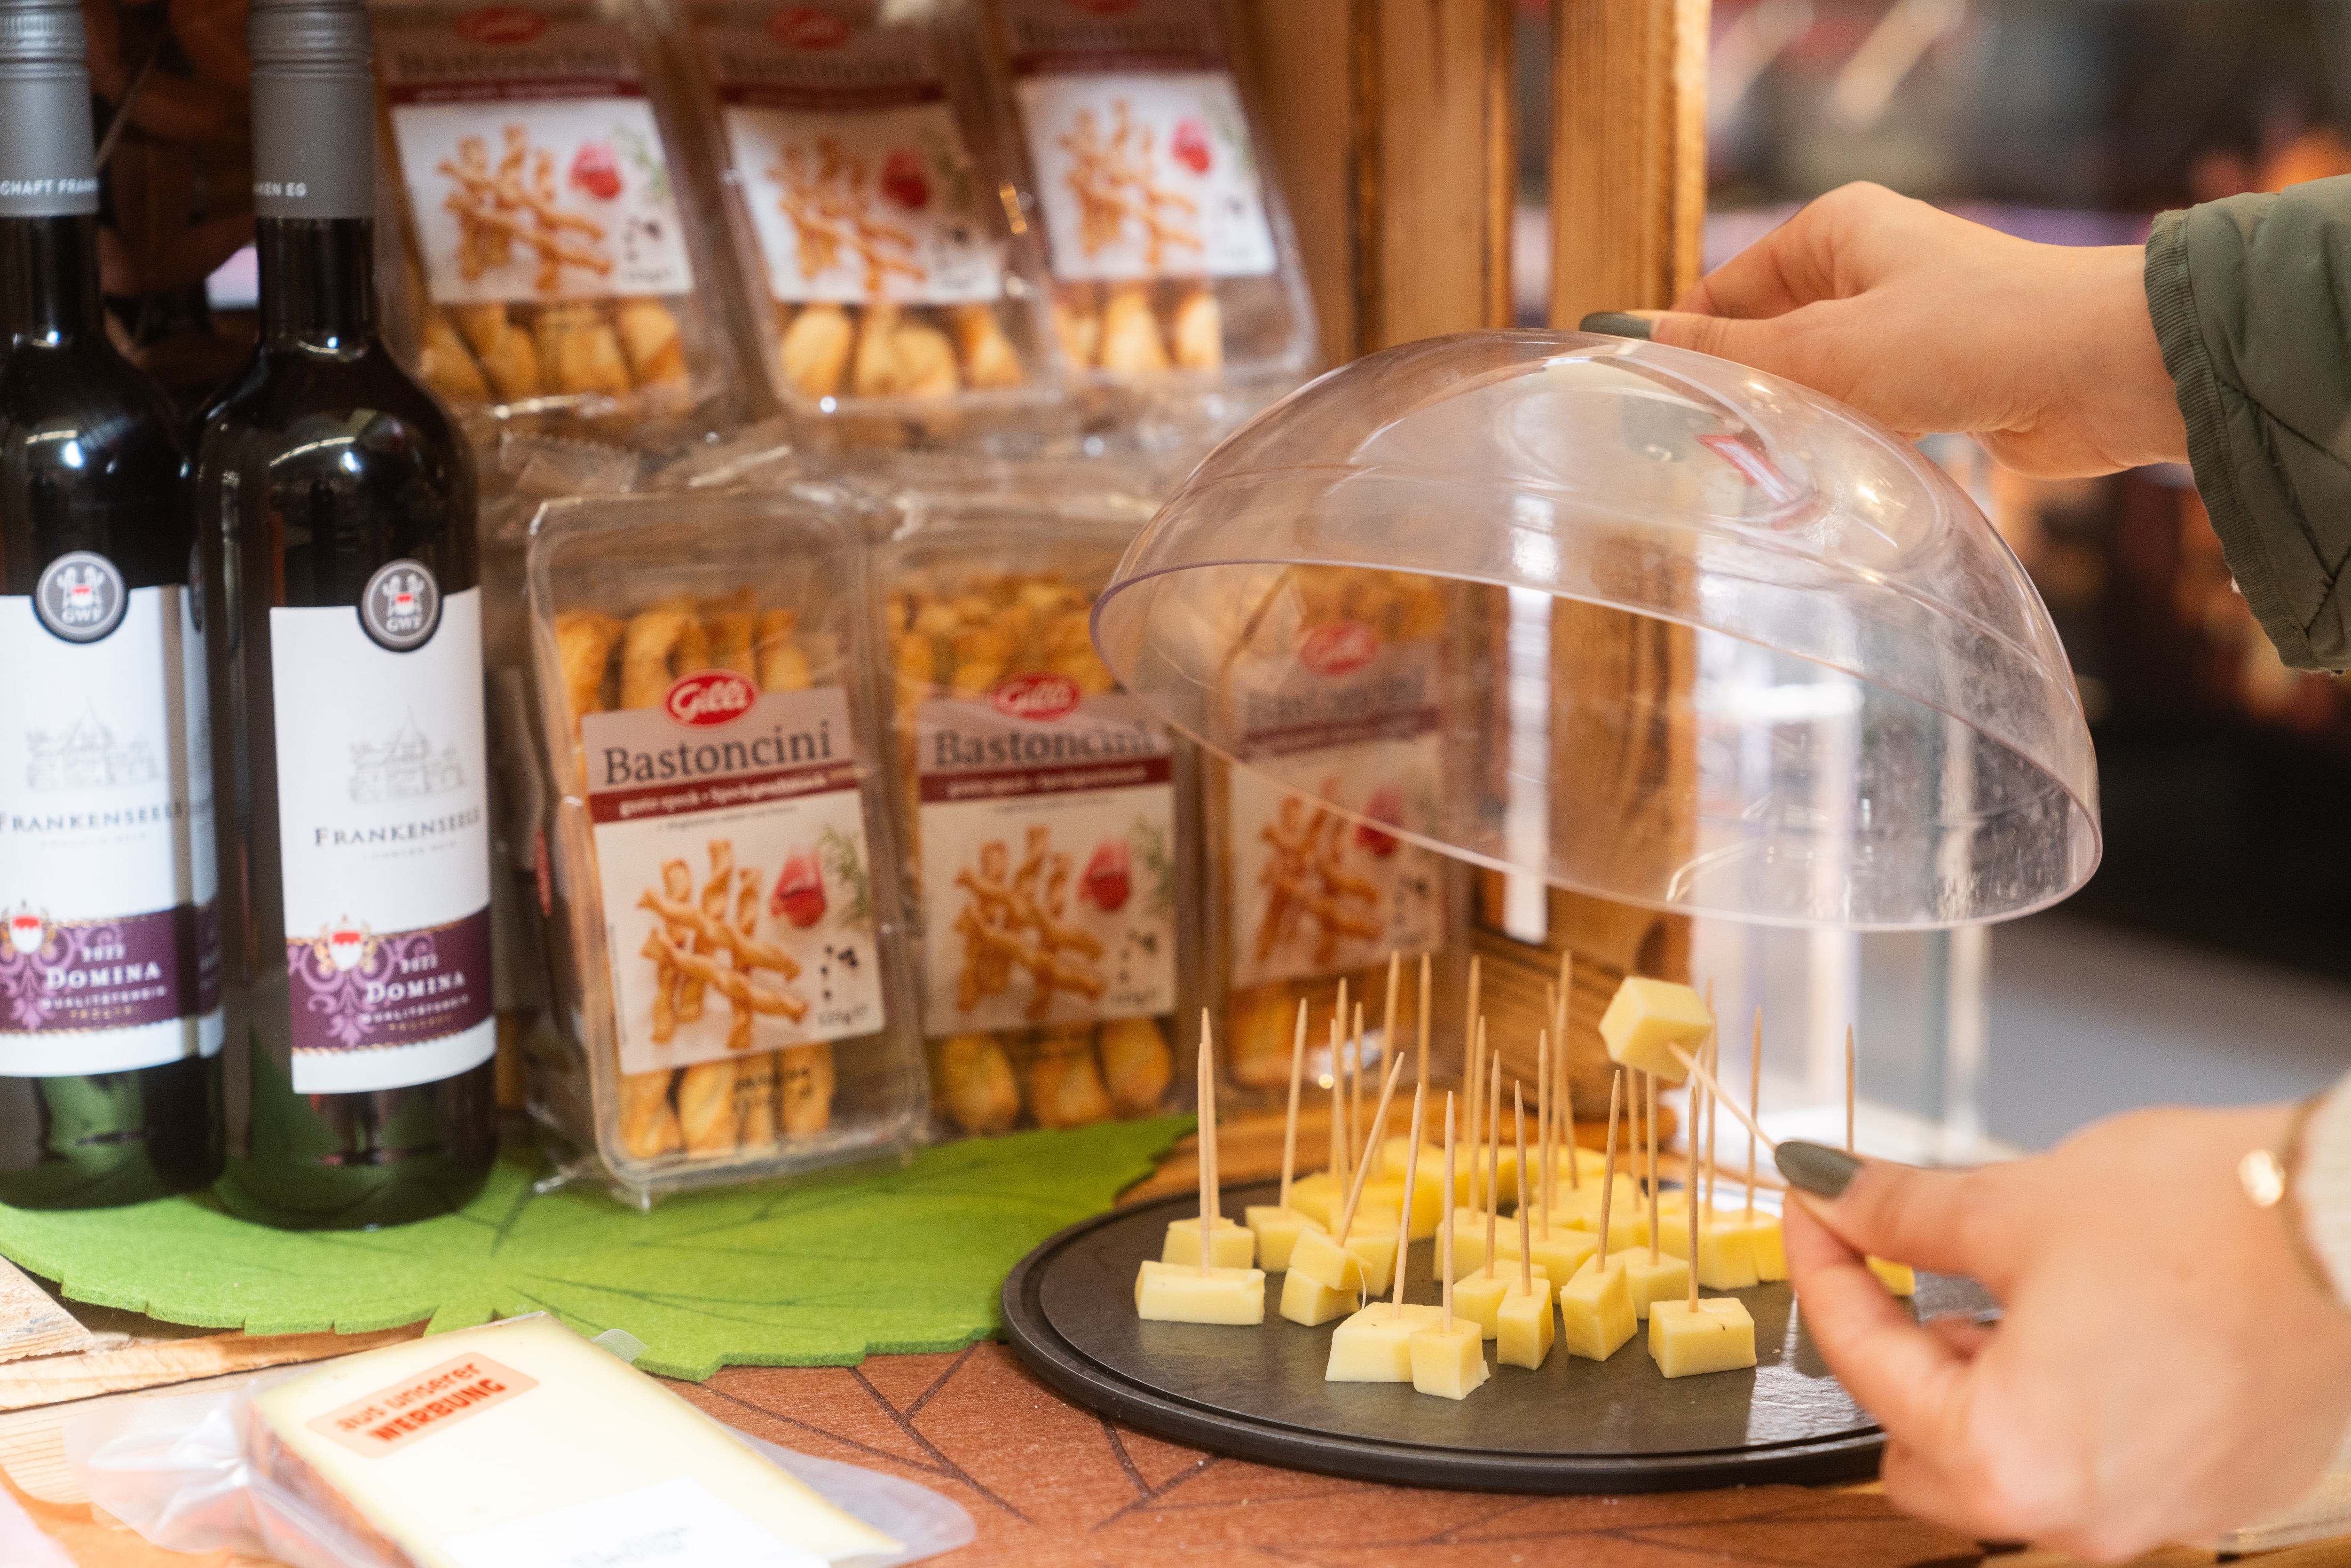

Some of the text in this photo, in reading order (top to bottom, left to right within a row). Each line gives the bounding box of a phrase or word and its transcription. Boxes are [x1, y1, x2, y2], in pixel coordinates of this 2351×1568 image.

[285, 182, 307, 197] EG
[62, 607, 102, 624] GWF
[387, 616, 422, 632] GWF
[604, 719, 832, 786] Bastoncini
[936, 720, 1154, 767] Bastoncini
[46, 960, 161, 990] DOMINA
[366, 969, 465, 1004] DOMINA
[335, 1363, 481, 1433] aus unserer
[368, 1378, 506, 1442] WERBUNG
